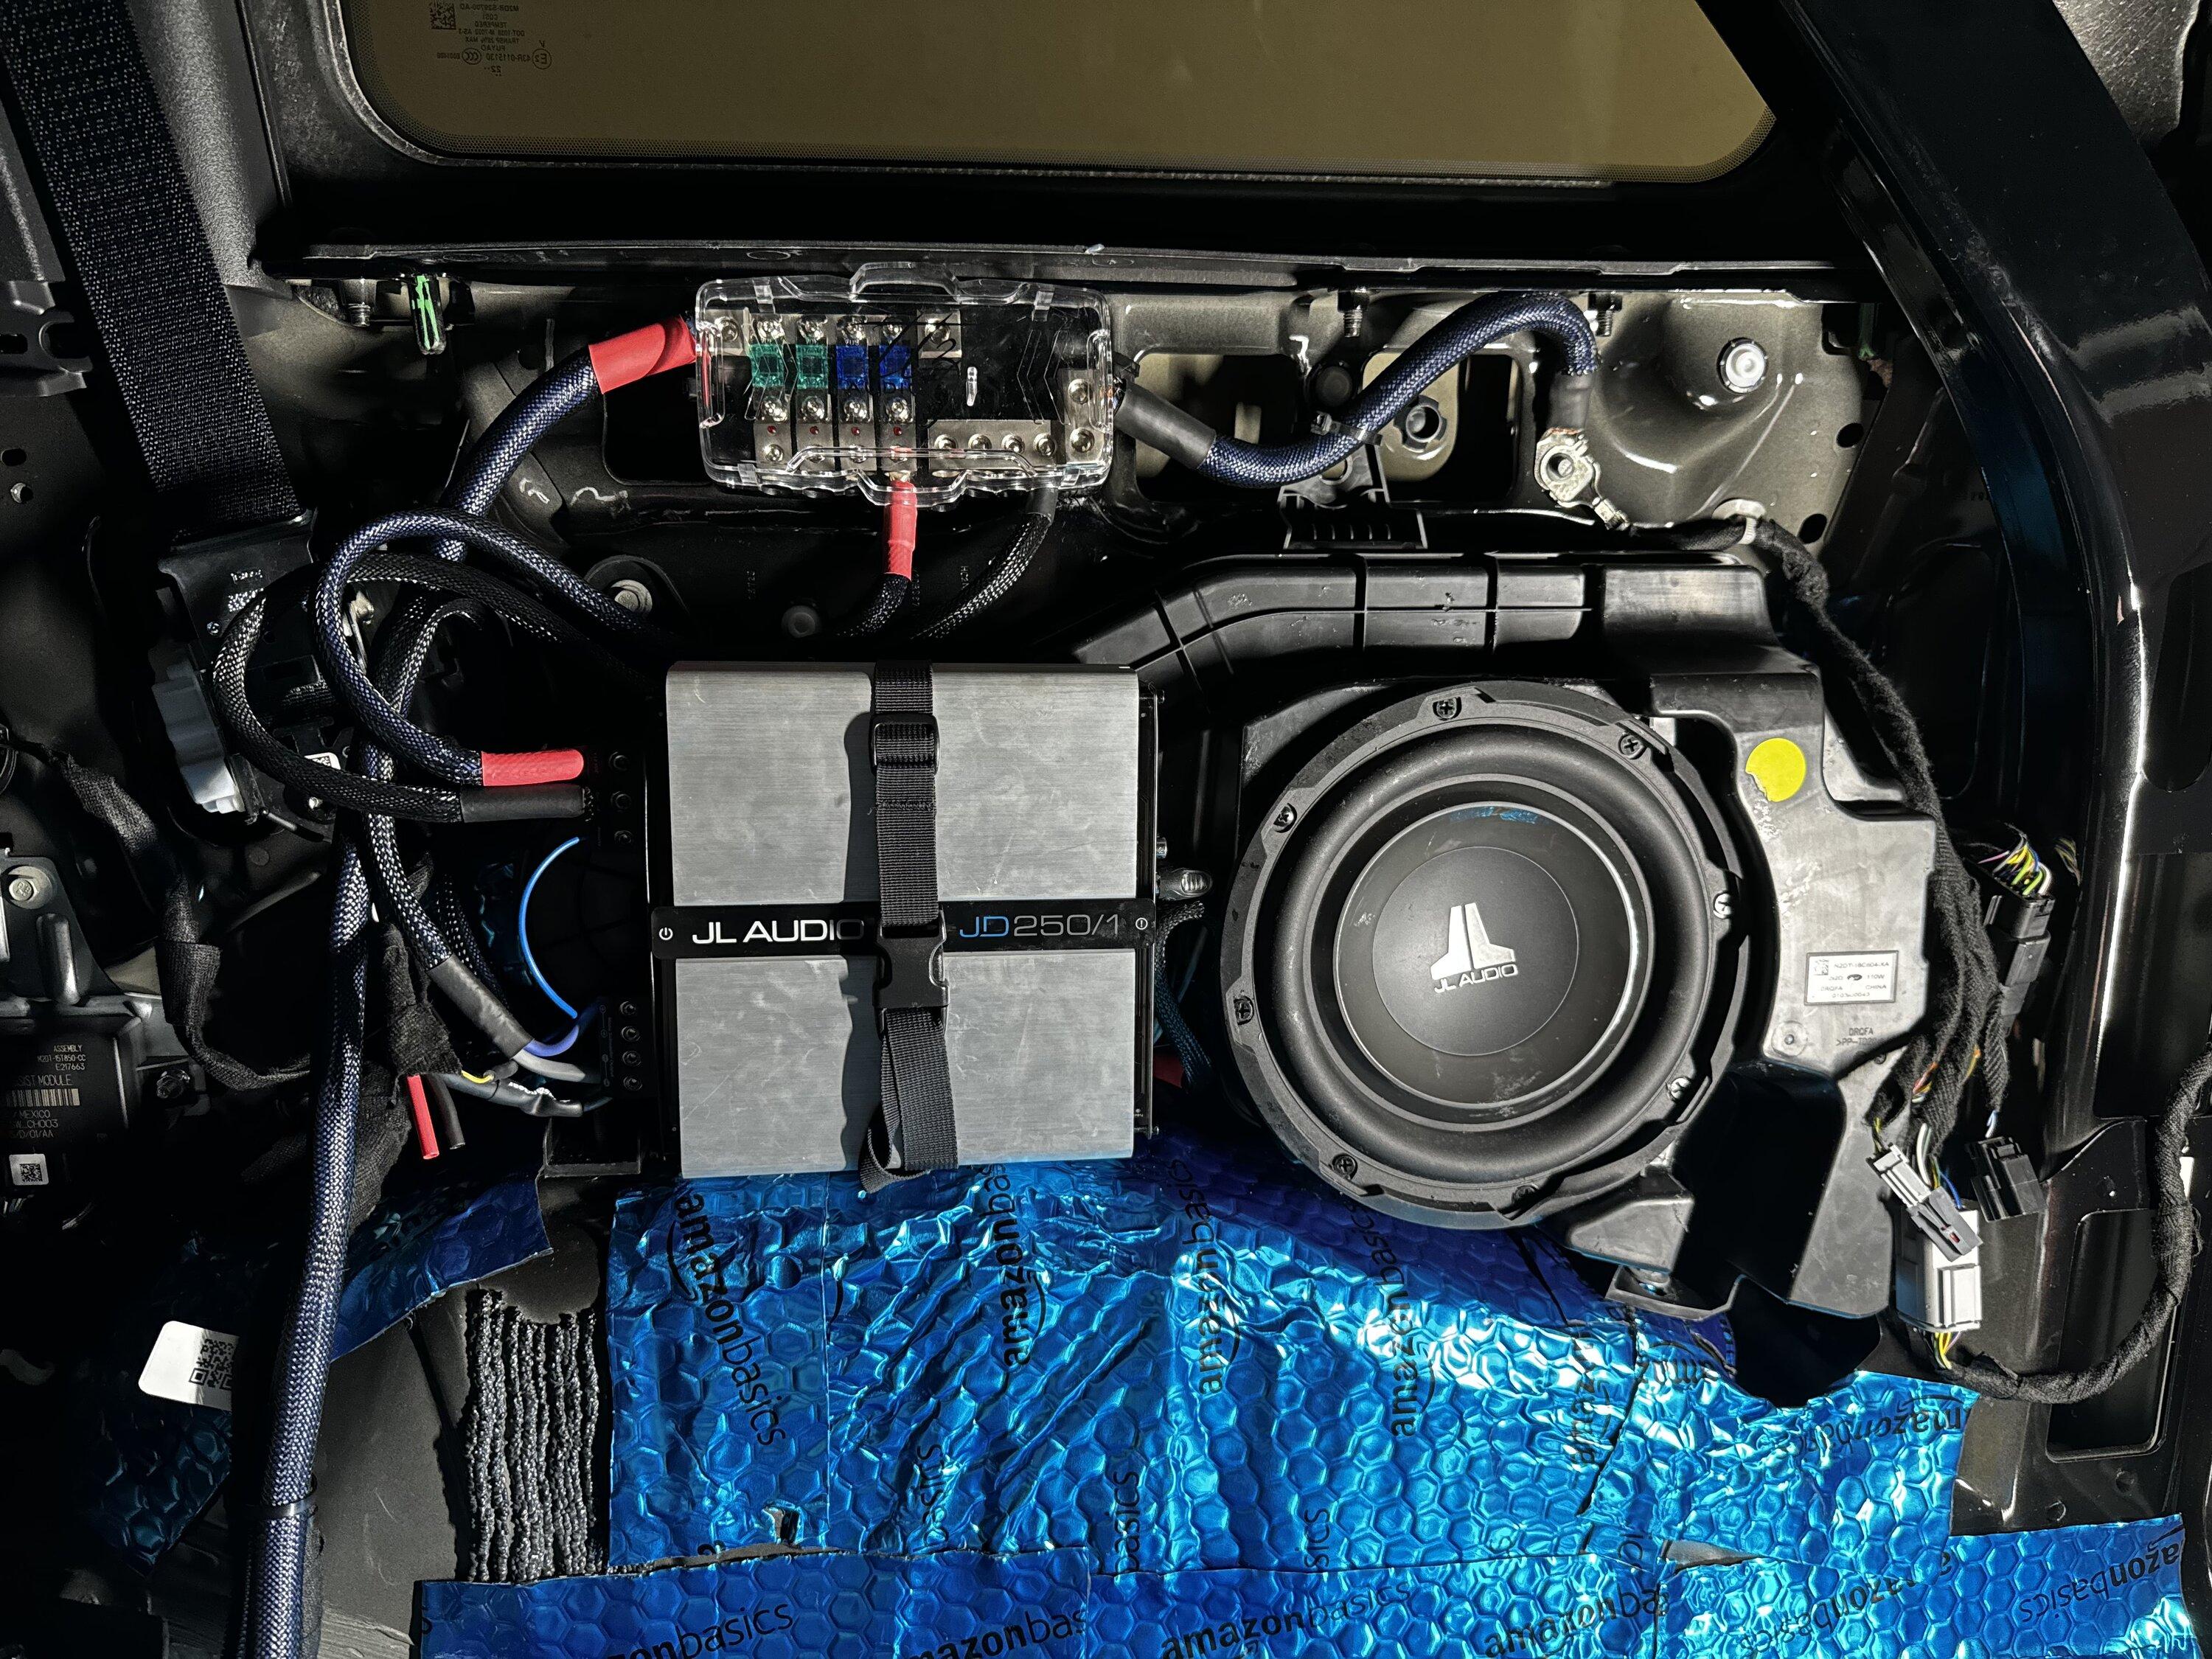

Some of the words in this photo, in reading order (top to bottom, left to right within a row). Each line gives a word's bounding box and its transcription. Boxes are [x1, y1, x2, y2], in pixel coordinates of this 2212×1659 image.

[692, 921, 737, 945] JL
[742, 919, 864, 944] AUDIO
[958, 914, 1120, 939] JD250/1
[1434, 978, 1456, 993] JL
[1458, 964, 1518, 987] AUDIO
[53, 1044, 83, 1053] ASSEMBLY
[55, 1062, 86, 1071] E217663
[38, 1074, 73, 1086] MODULE
[674, 1192, 787, 1447] amazonbasics
